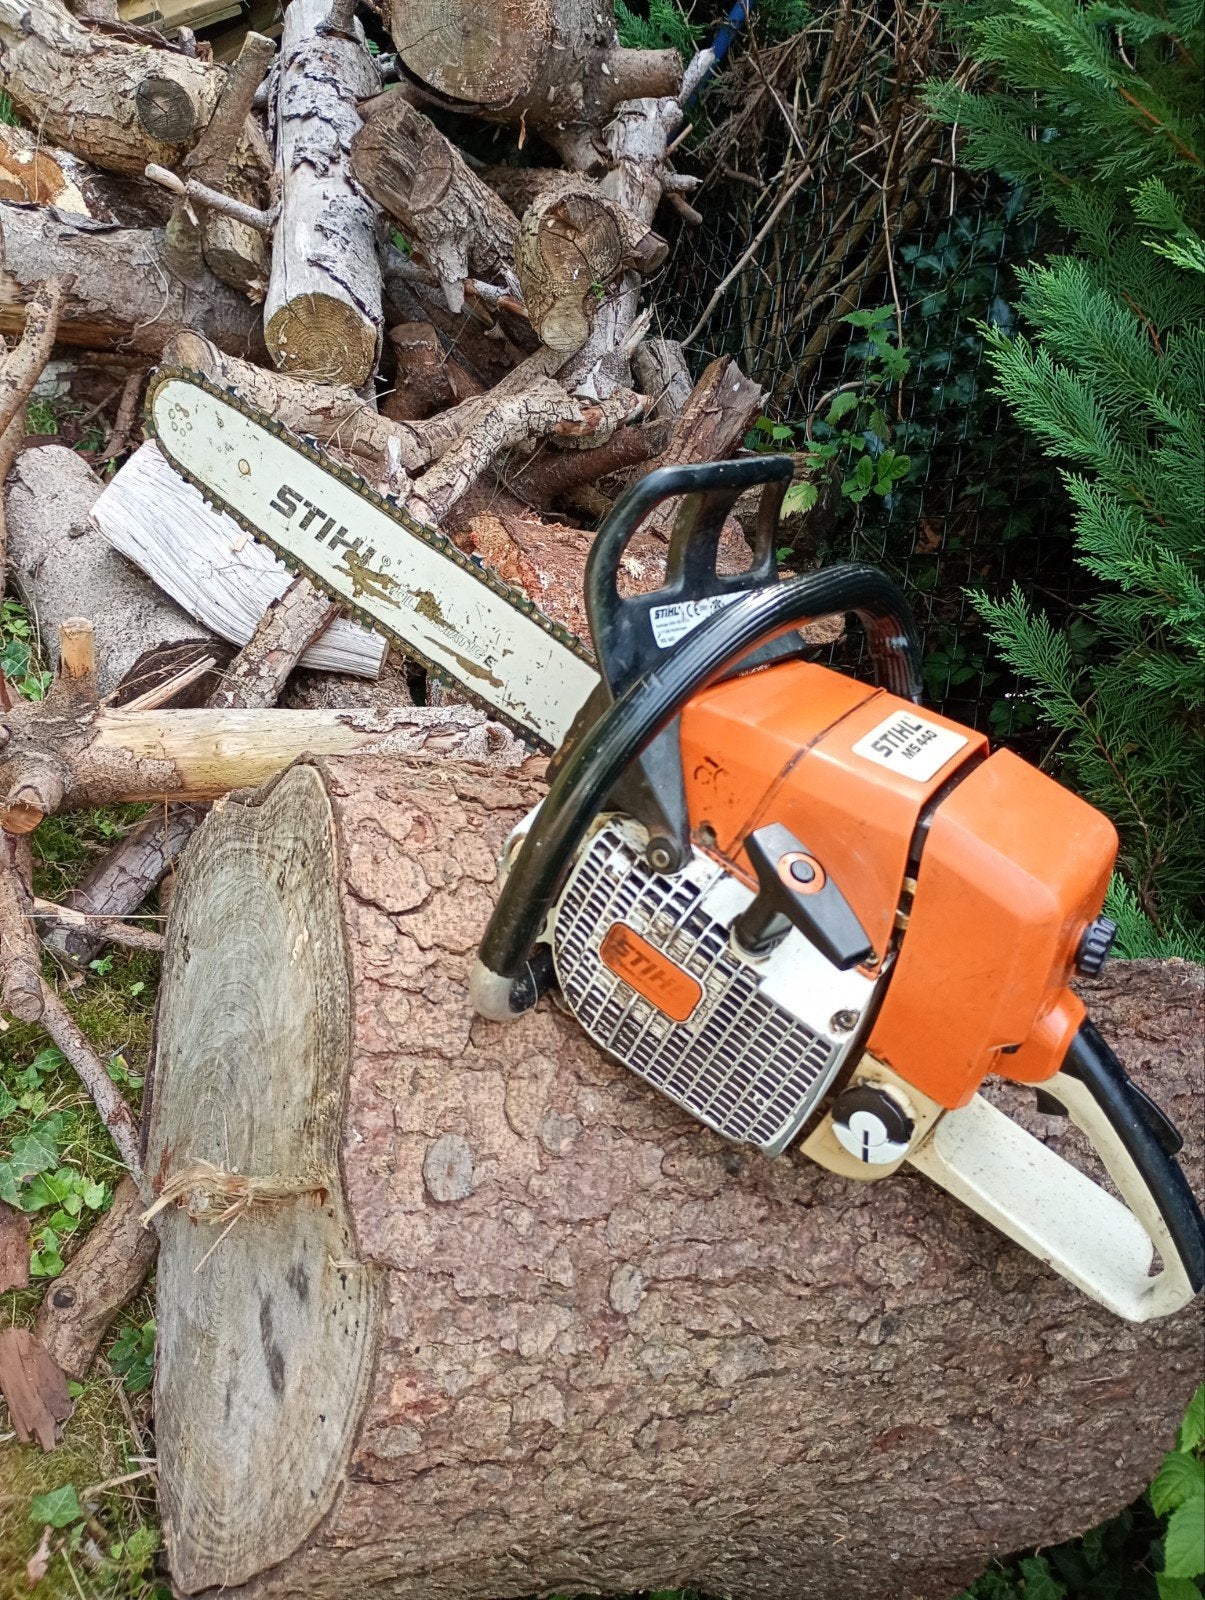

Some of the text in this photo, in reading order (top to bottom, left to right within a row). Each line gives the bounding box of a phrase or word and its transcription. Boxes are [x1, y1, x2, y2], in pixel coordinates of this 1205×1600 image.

[655, 606, 680, 619] STIHL
[484, 655, 498, 669] E
[870, 719, 923, 758] STIHL
[900, 729, 938, 760] MS 440
